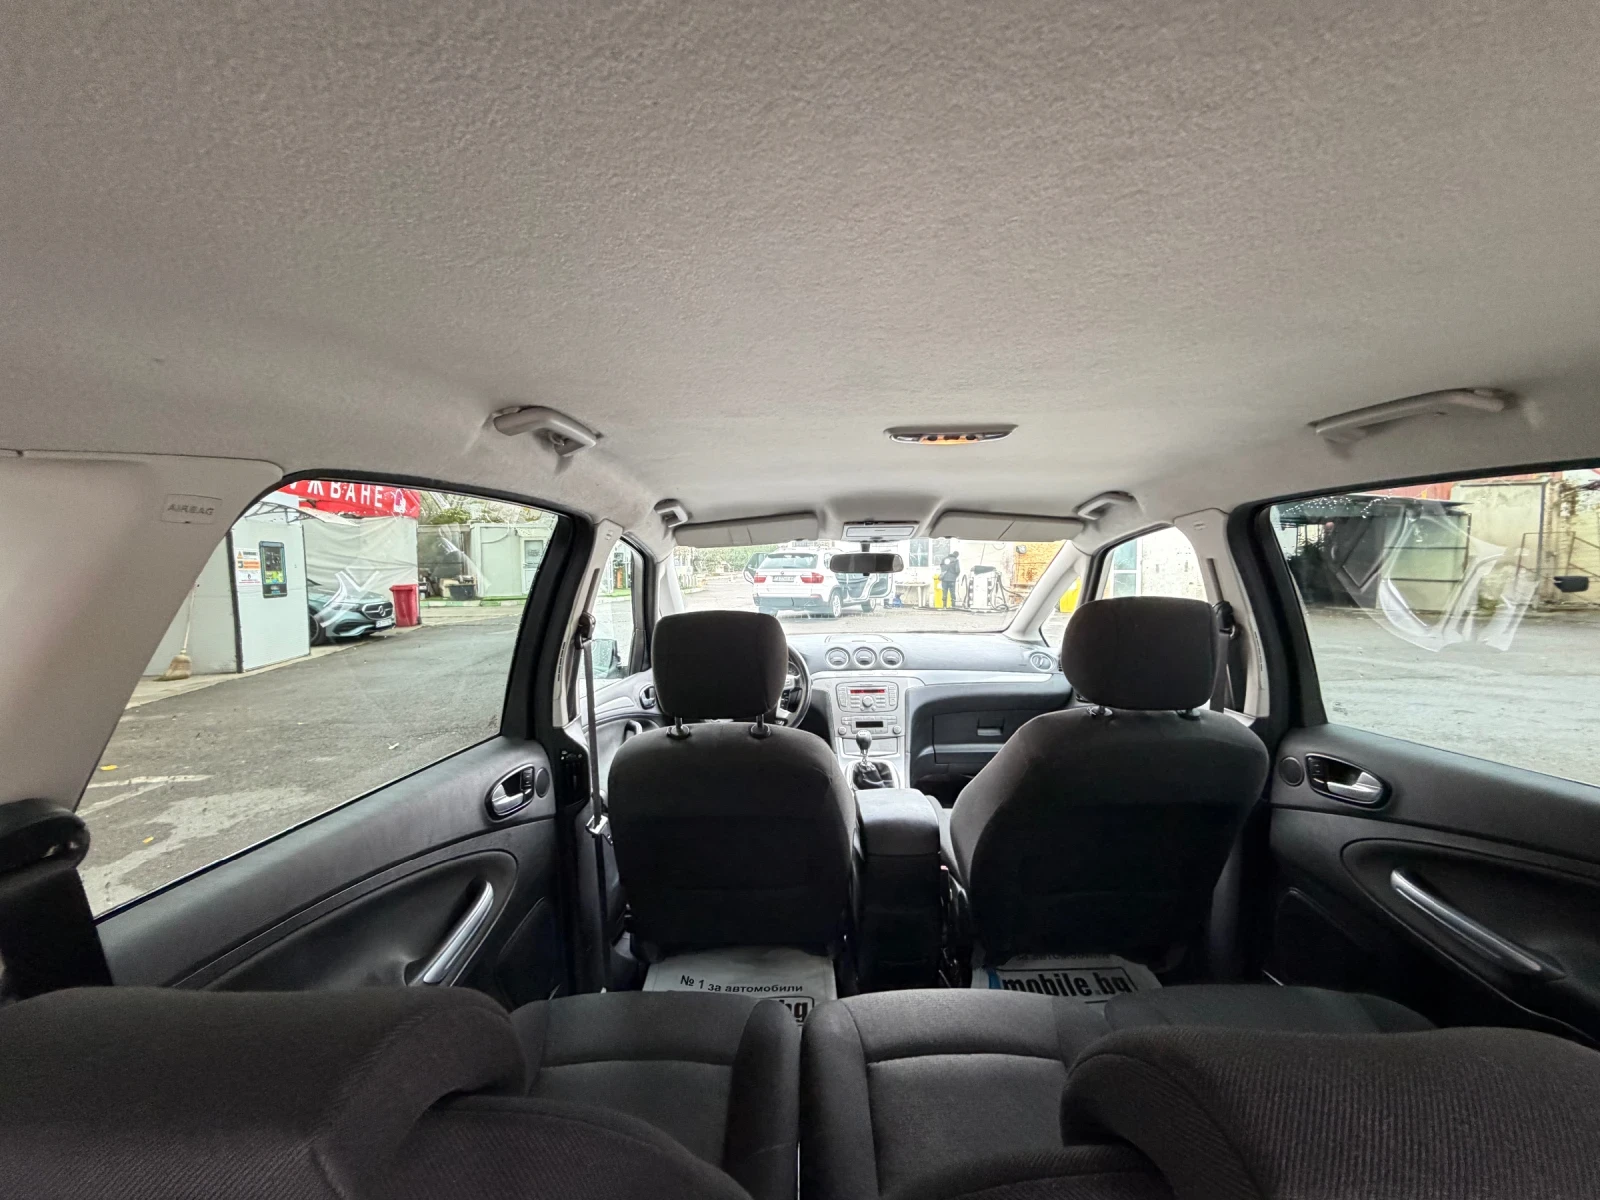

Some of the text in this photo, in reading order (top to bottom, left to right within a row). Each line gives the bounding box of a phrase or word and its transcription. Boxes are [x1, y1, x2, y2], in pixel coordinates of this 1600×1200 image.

[167, 503, 215, 515] AIRBAG
[698, 980, 705, 989] 1
[707, 984, 721, 992] за
[724, 985, 803, 993] автомобили
